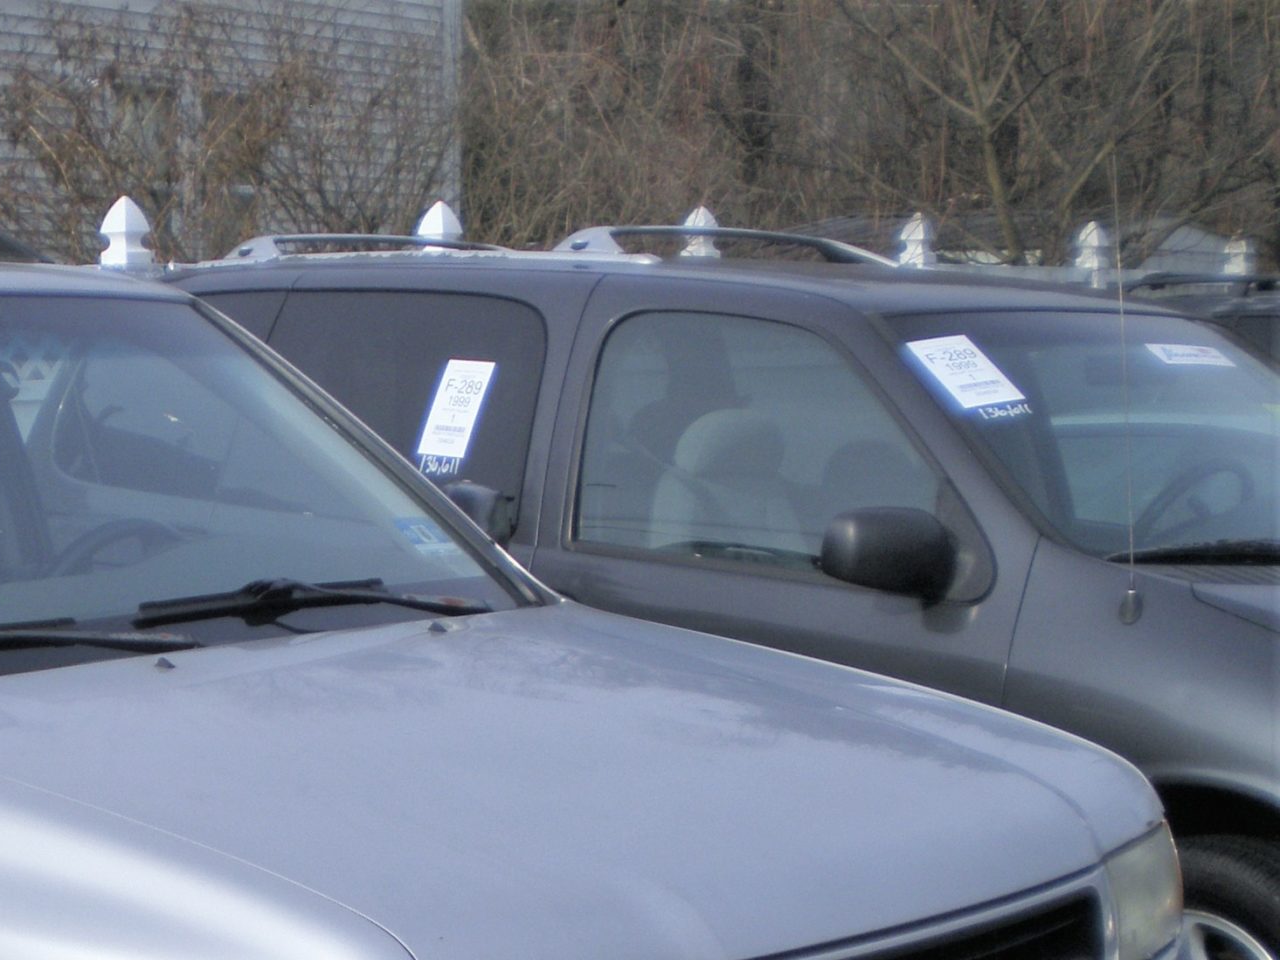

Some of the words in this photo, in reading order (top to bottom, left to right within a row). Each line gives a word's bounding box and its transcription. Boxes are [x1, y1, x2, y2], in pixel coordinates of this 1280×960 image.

[925, 348, 977, 364] F-289
[945, 359, 978, 371] 1999
[445, 378, 483, 395] F-289
[449, 395, 471, 407] 1999
[419, 454, 460, 476] 136,611
